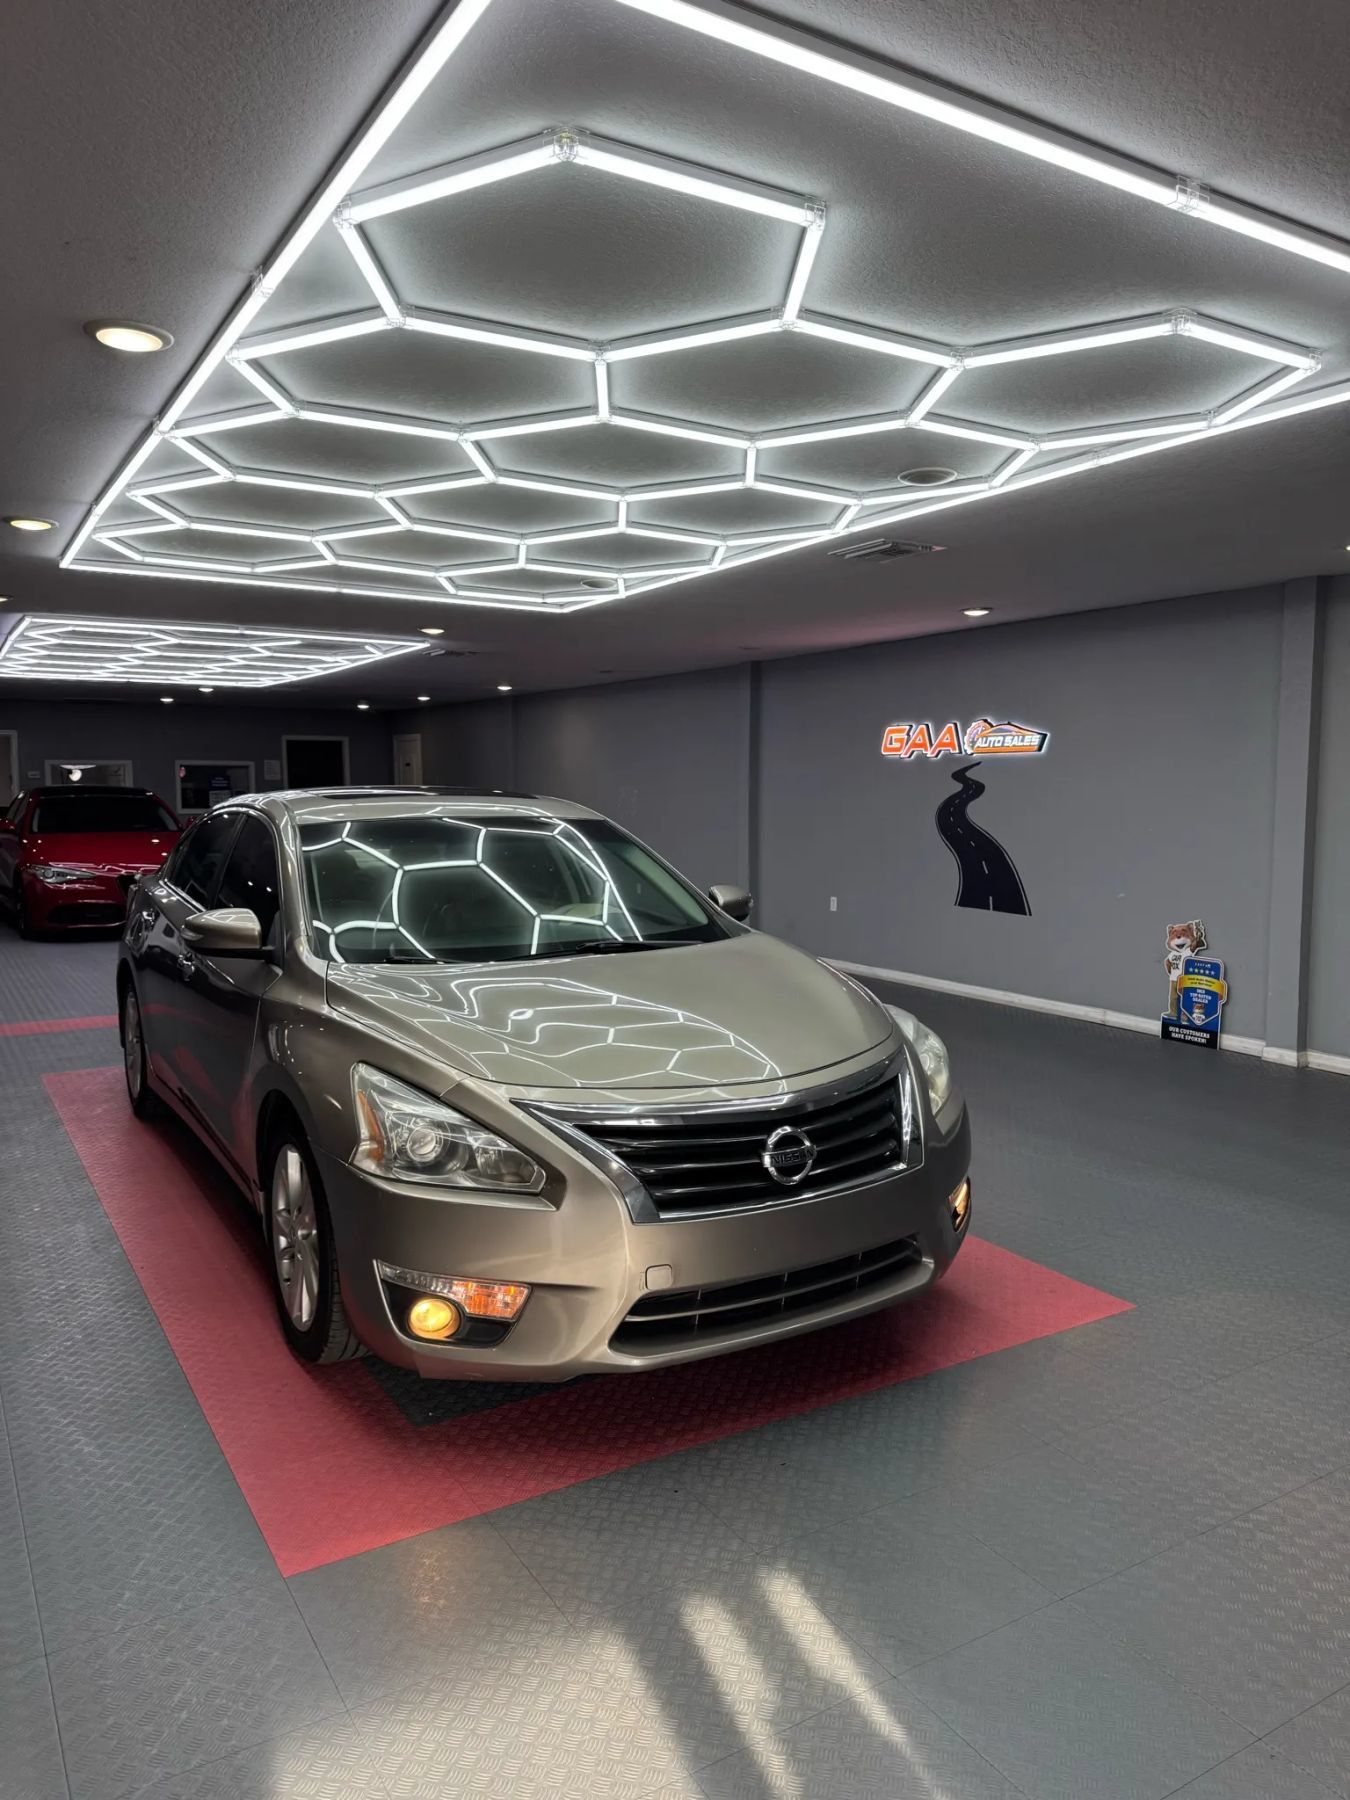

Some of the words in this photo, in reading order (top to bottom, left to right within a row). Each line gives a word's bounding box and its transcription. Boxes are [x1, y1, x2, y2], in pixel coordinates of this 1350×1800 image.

[882, 723, 961, 758] GAA
[975, 736, 1004, 748] AUTO
[1003, 734, 1040, 747] SALES
[1171, 1032, 1184, 1040] HAVE
[1180, 1028, 1210, 1039] CUSTOMERS
